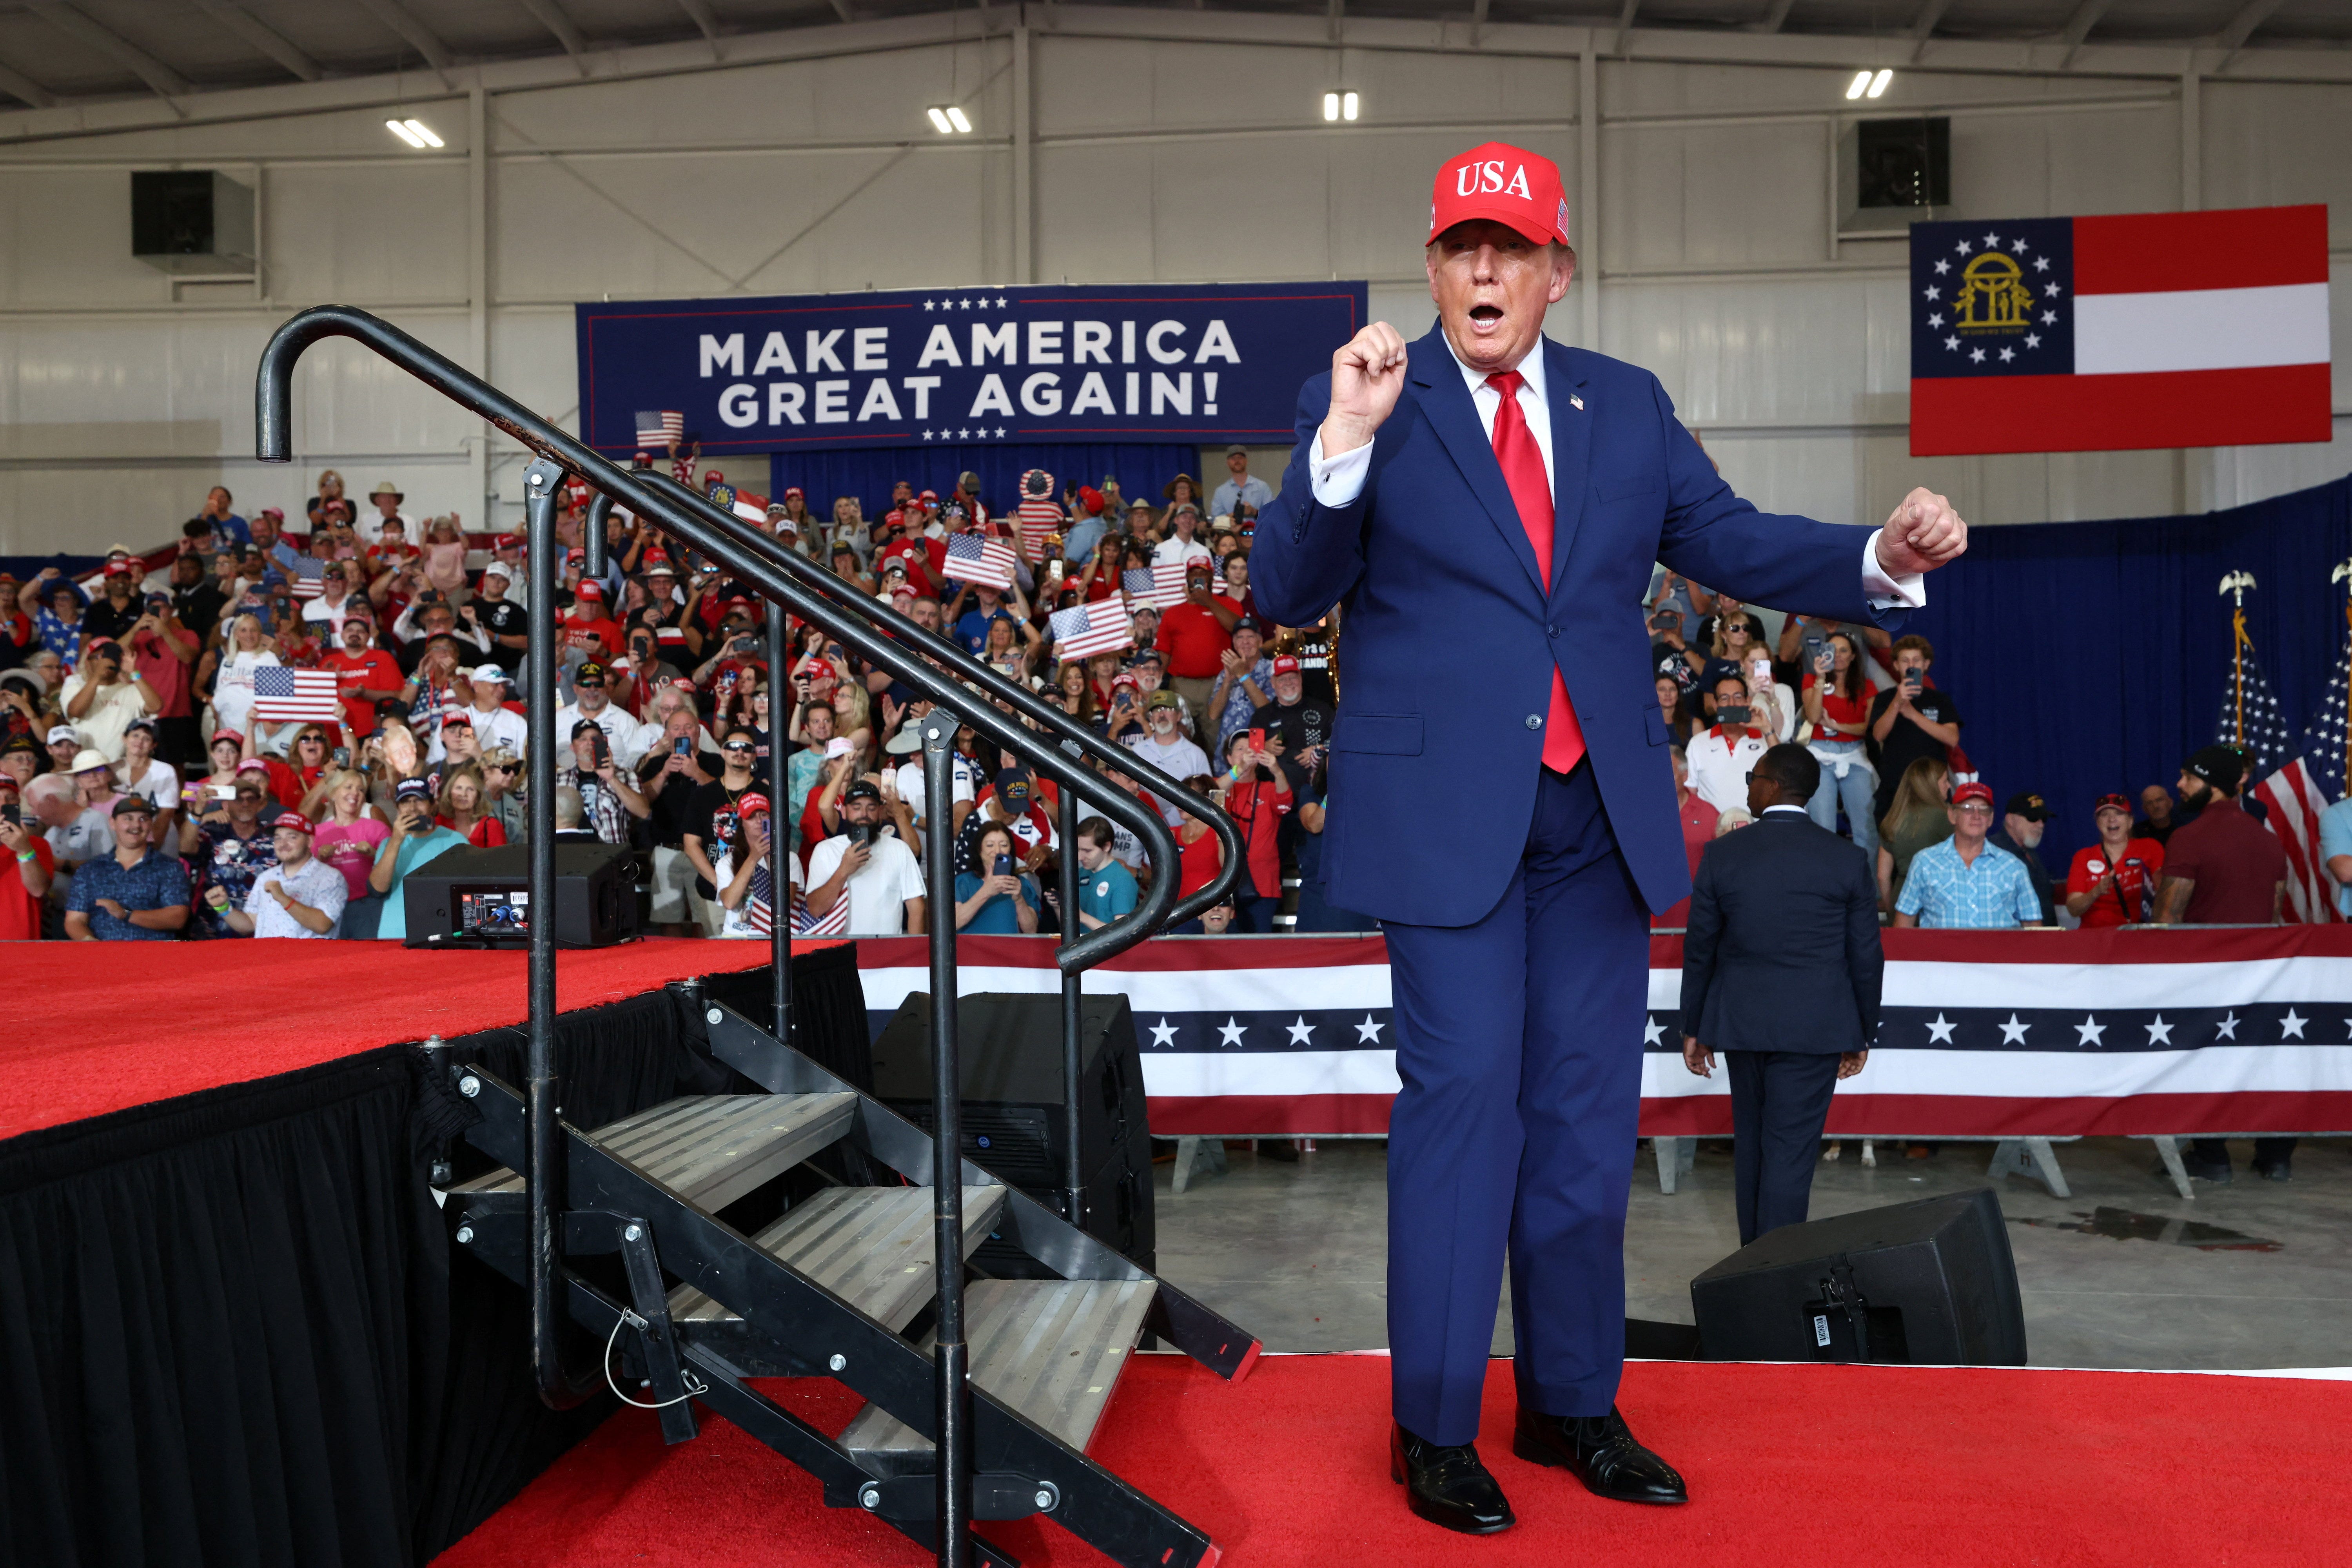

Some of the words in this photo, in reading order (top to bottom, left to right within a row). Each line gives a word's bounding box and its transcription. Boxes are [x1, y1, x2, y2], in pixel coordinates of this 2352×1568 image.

[1457, 160, 1532, 201] USA
[700, 327, 889, 377] MAKE
[917, 320, 1241, 368] AMERICA
[718, 375, 941, 428] GREAT
[969, 372, 1219, 418] AGAIN!
[397, 779, 425, 791] TRUMP
